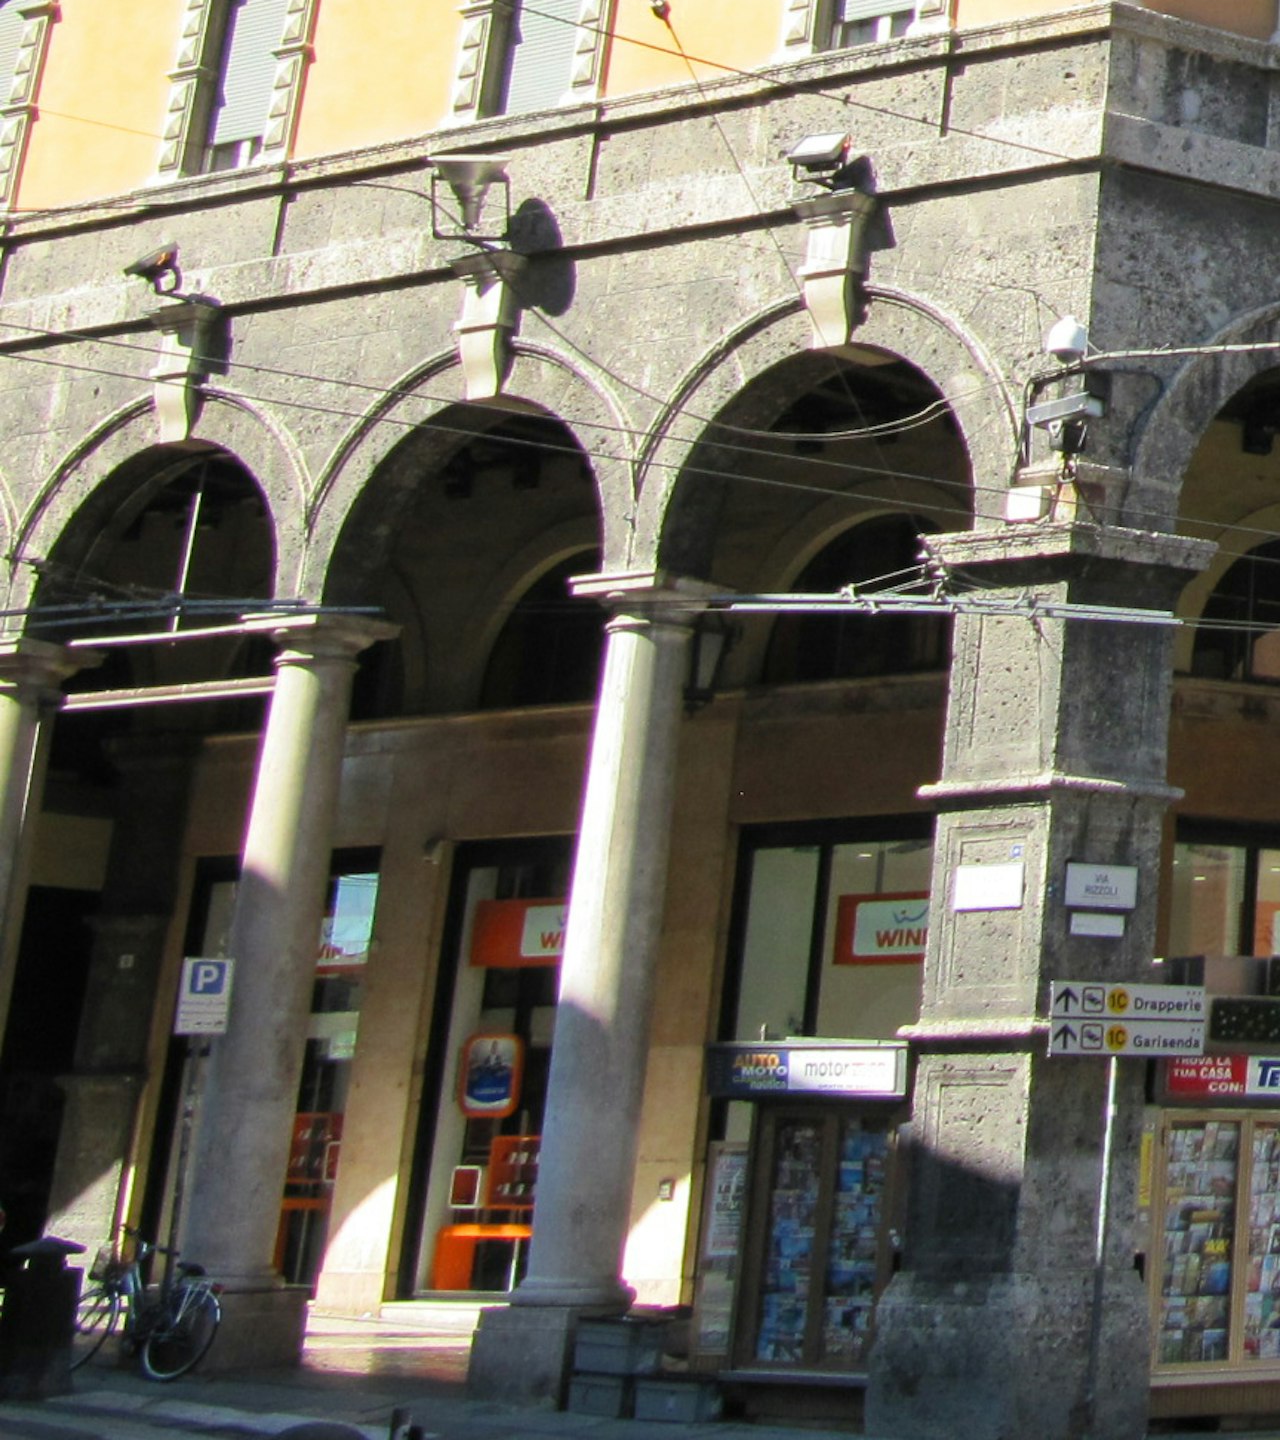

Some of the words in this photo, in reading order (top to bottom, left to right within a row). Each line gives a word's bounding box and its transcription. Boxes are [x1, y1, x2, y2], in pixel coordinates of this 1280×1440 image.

[1094, 873, 1110, 884] VIA
[1084, 884, 1119, 896] RIZZOLI
[195, 965, 220, 992] P
[1109, 993, 1127, 1009] 1C
[1134, 997, 1202, 1013] Drapperie
[1108, 1030, 1126, 1045] 1C
[1133, 1034, 1200, 1048] Garisenda
[735, 1053, 780, 1067] AUTO
[1216, 1056, 1232, 1066] LA
[741, 1065, 788, 1077] MOTO
[1173, 1068, 1197, 1078] TUA
[1199, 1067, 1232, 1079] CASA
[1208, 1081, 1244, 1093] CON:
